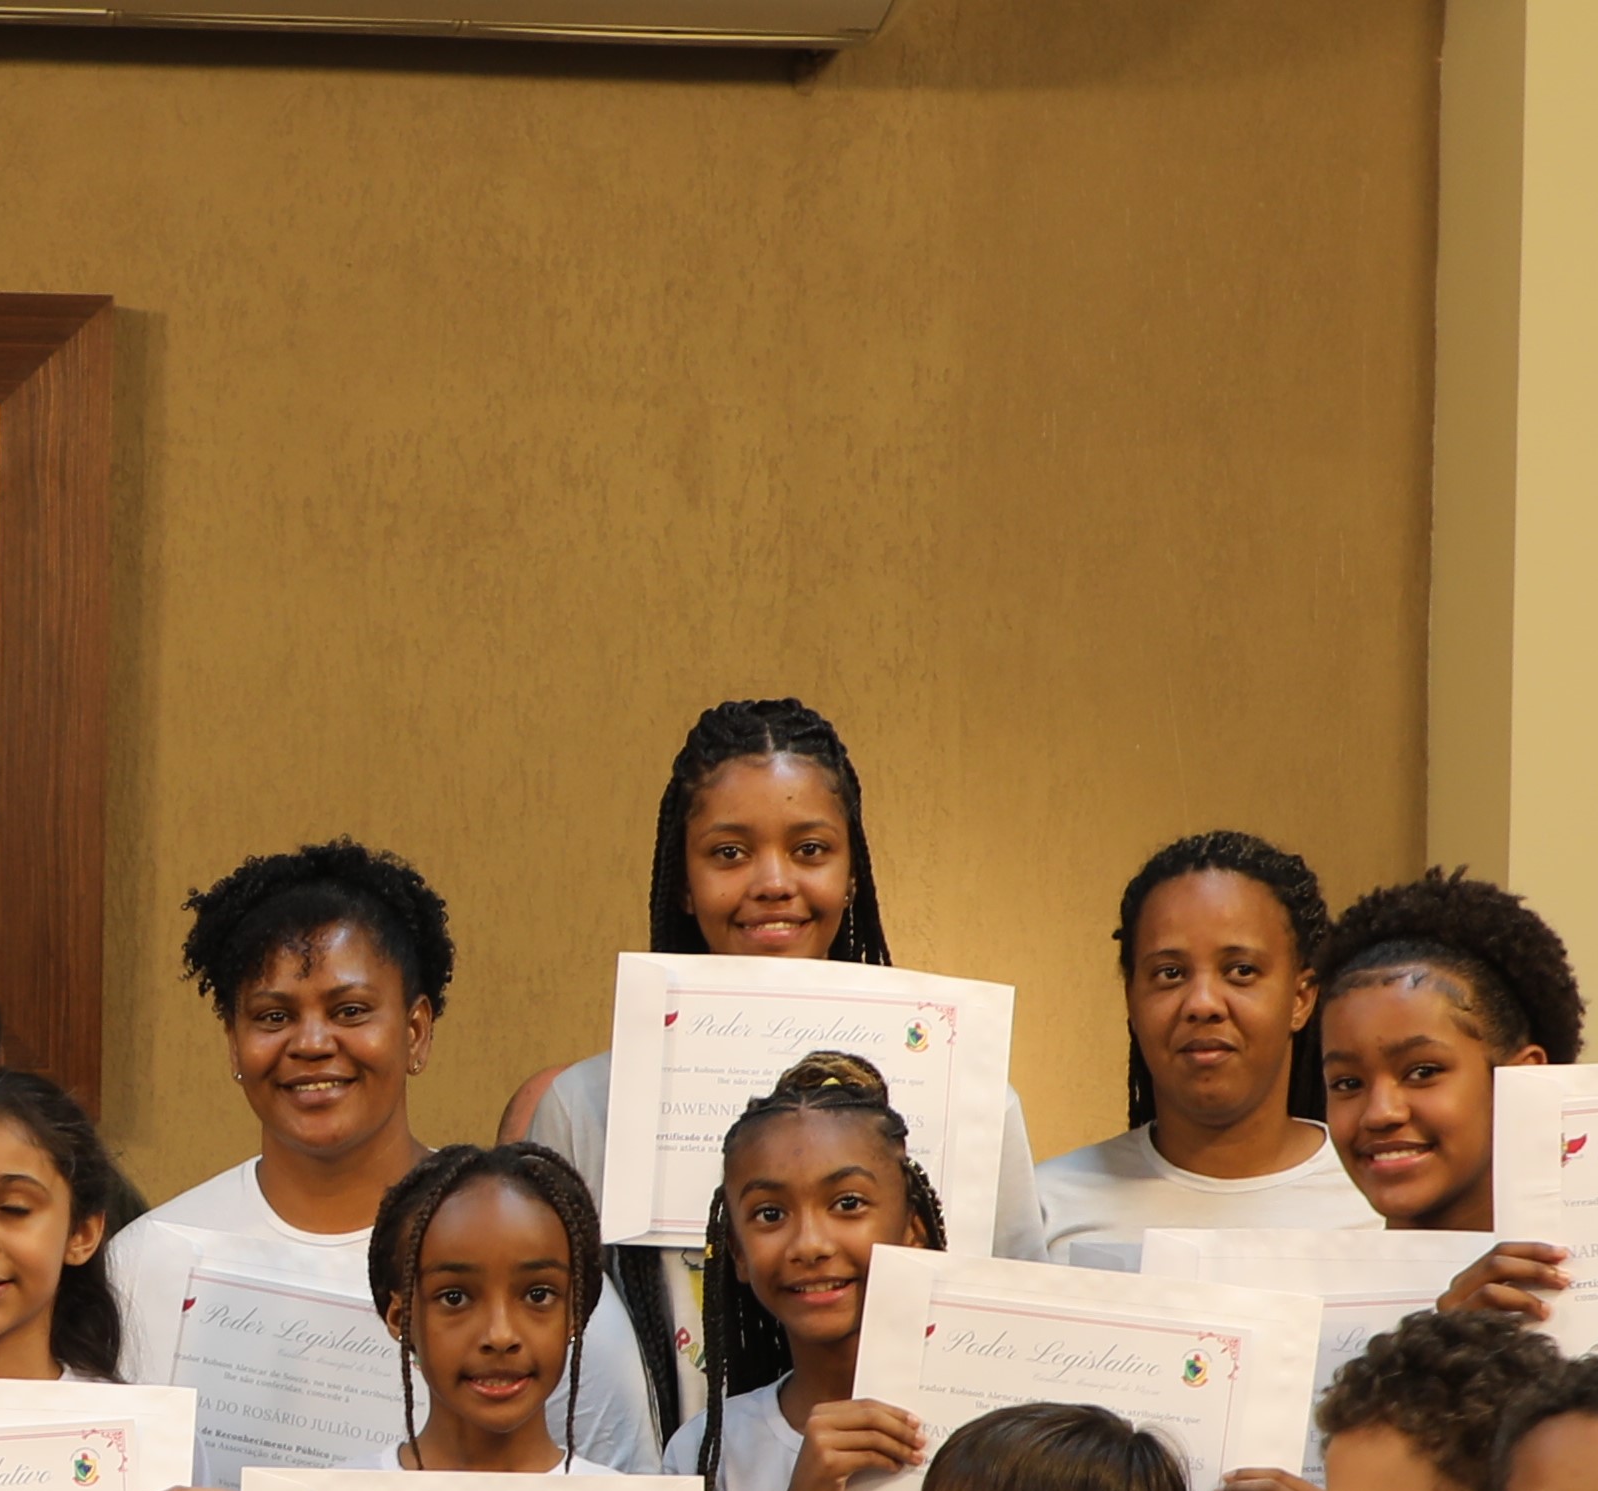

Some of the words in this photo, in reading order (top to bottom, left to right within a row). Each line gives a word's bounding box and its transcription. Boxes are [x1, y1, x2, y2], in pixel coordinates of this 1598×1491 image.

[215, 1399, 239, 1415] DO
[242, 1404, 307, 1429] ROSÁRIO
[310, 1417, 362, 1439] JULIÃO
